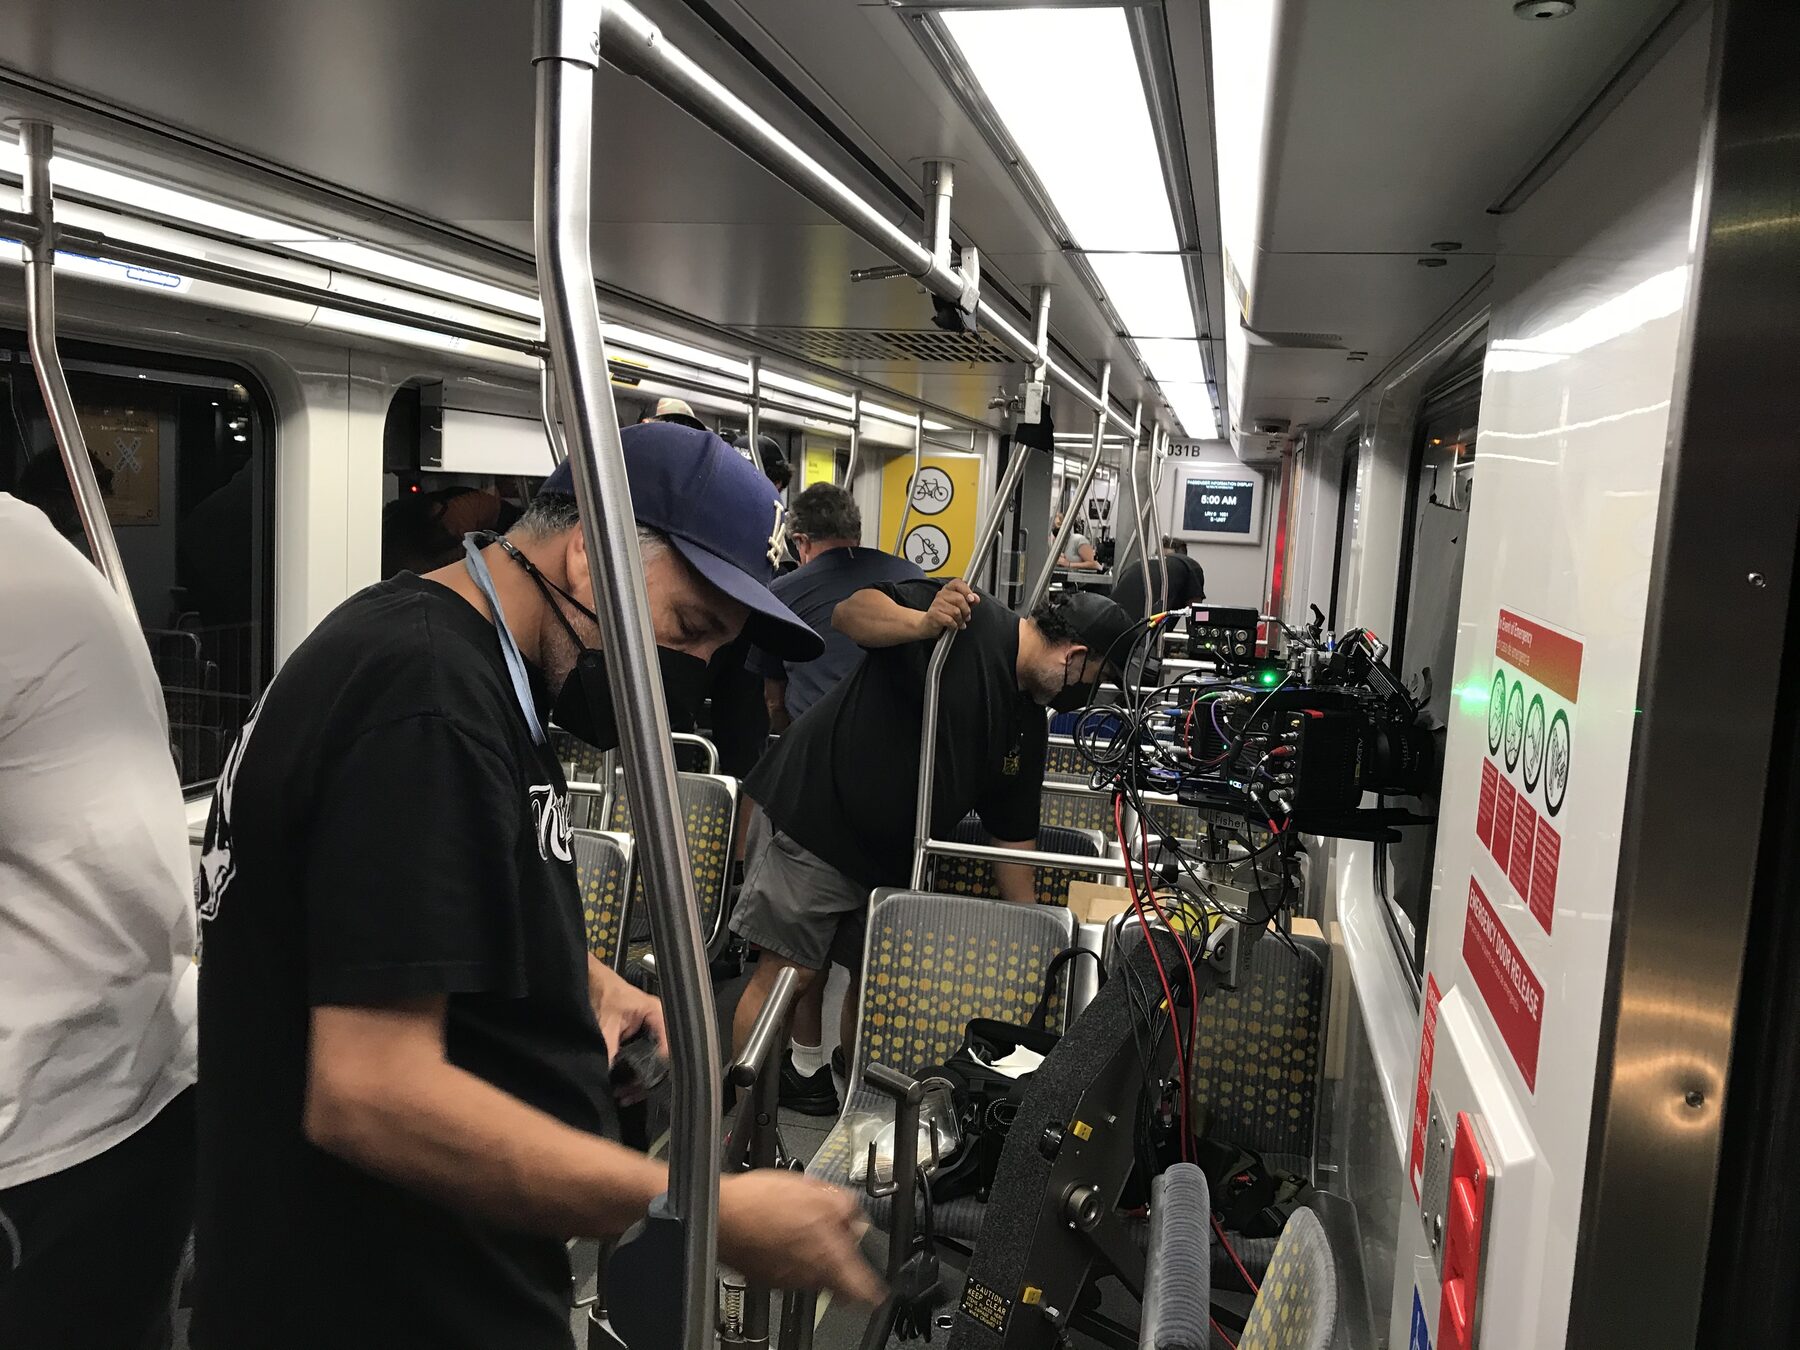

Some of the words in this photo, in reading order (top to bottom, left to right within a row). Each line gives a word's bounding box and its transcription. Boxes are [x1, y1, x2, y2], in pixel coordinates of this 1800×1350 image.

[1221, 495, 1237, 505] AM
[1469, 887, 1498, 947] EMERGENCY
[1495, 930, 1512, 972] DOOR
[1510, 957, 1540, 1022] RELEASE
[968, 1288, 983, 1300] KEEP
[986, 1299, 1006, 1315] CLEAR
[976, 1284, 1003, 1304] CAUTION
